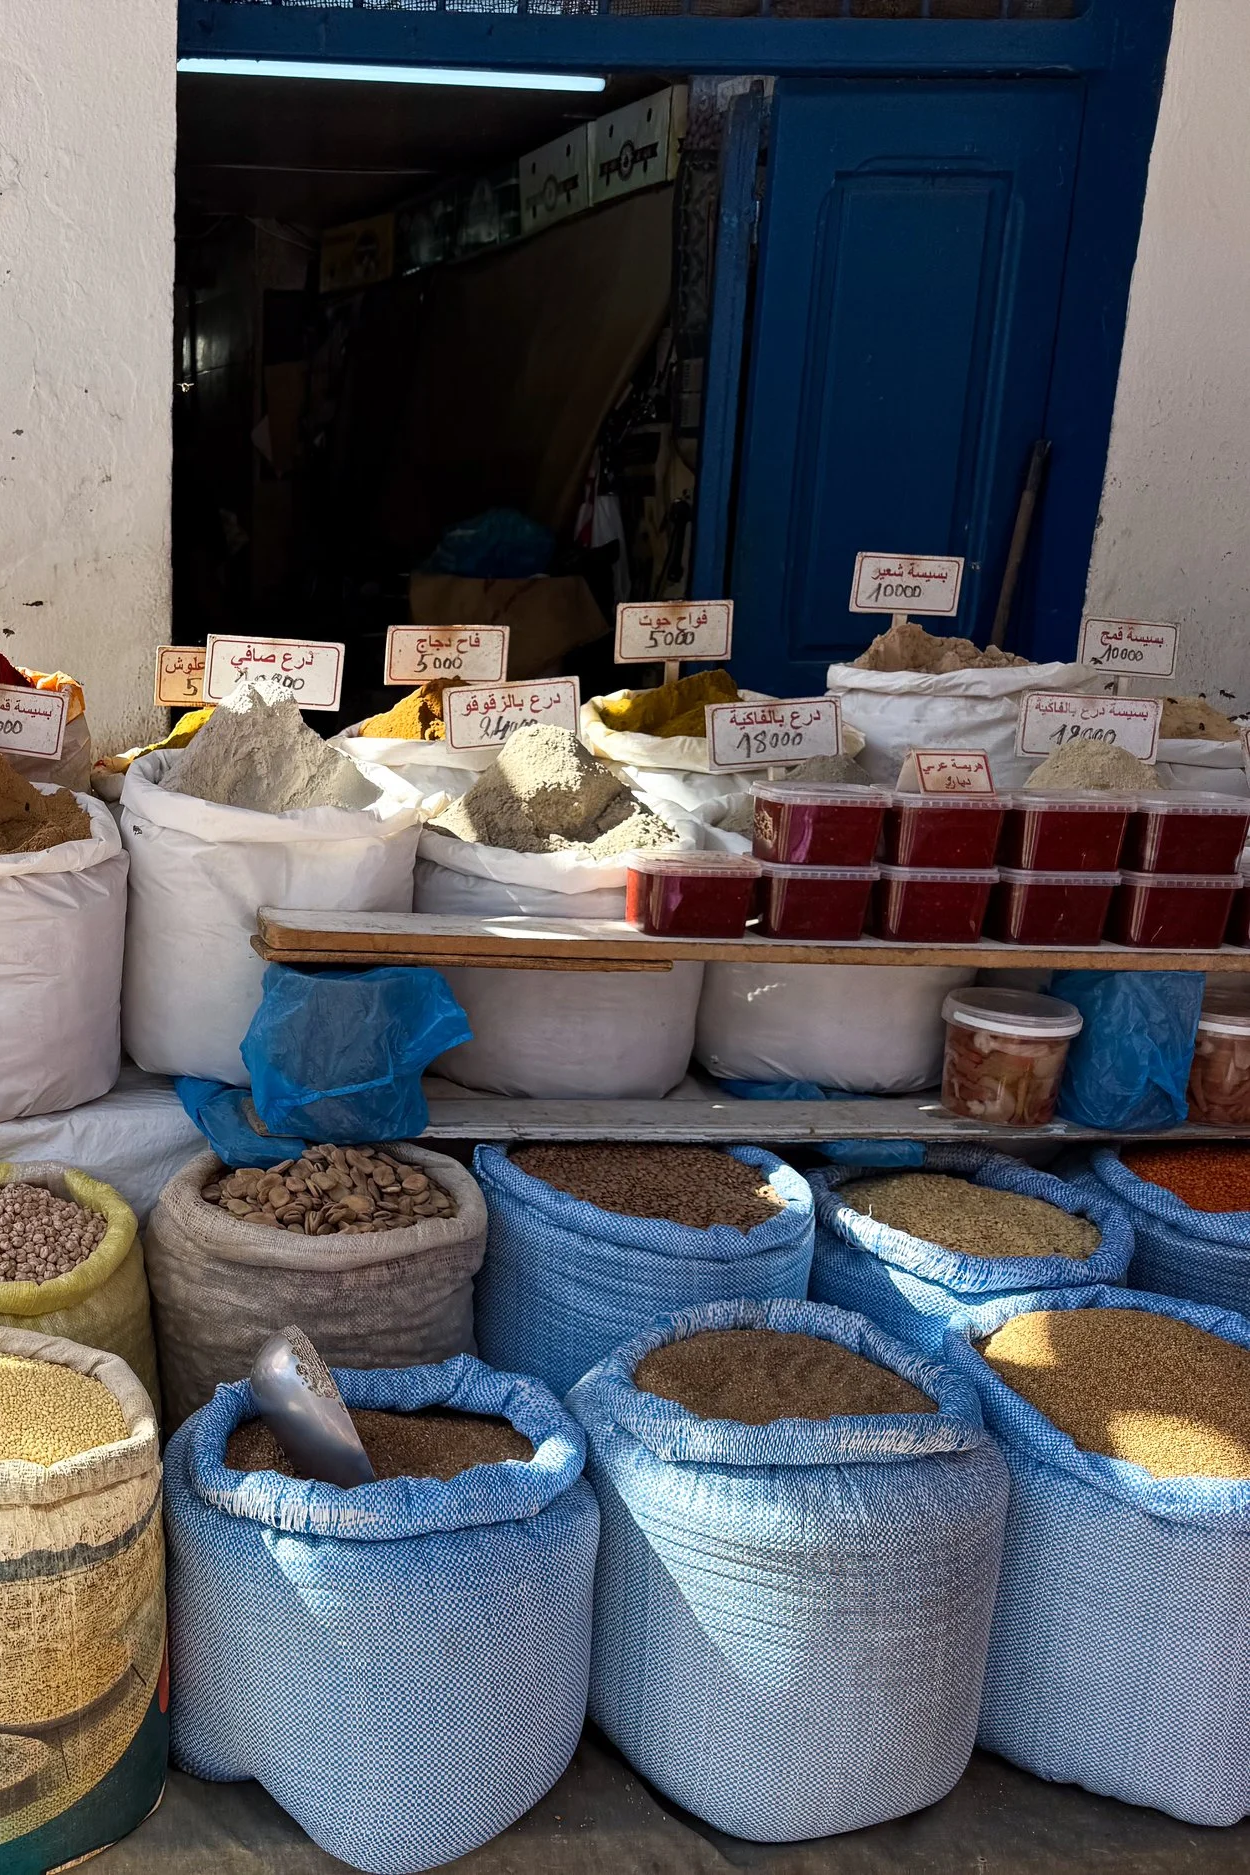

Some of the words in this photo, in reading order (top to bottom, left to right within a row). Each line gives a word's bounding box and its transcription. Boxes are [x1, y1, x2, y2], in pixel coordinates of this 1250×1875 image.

[865, 583, 922, 602] 10000
[416, 634, 451, 653] دجاج
[645, 630, 695, 648] 5000
[1100, 626, 1123, 646] قمح
[230, 645, 276, 668] صافي
[414, 653, 463, 672] 5000
[1100, 644, 1143, 662] 10000
[14, 699, 52, 720] بسيسة
[529, 693, 561, 713] درع
[730, 709, 785, 730] بالفاكية
[790, 709, 821, 729] درع
[1080, 707, 1105, 720] درع
[736, 730, 803, 758] 18000
